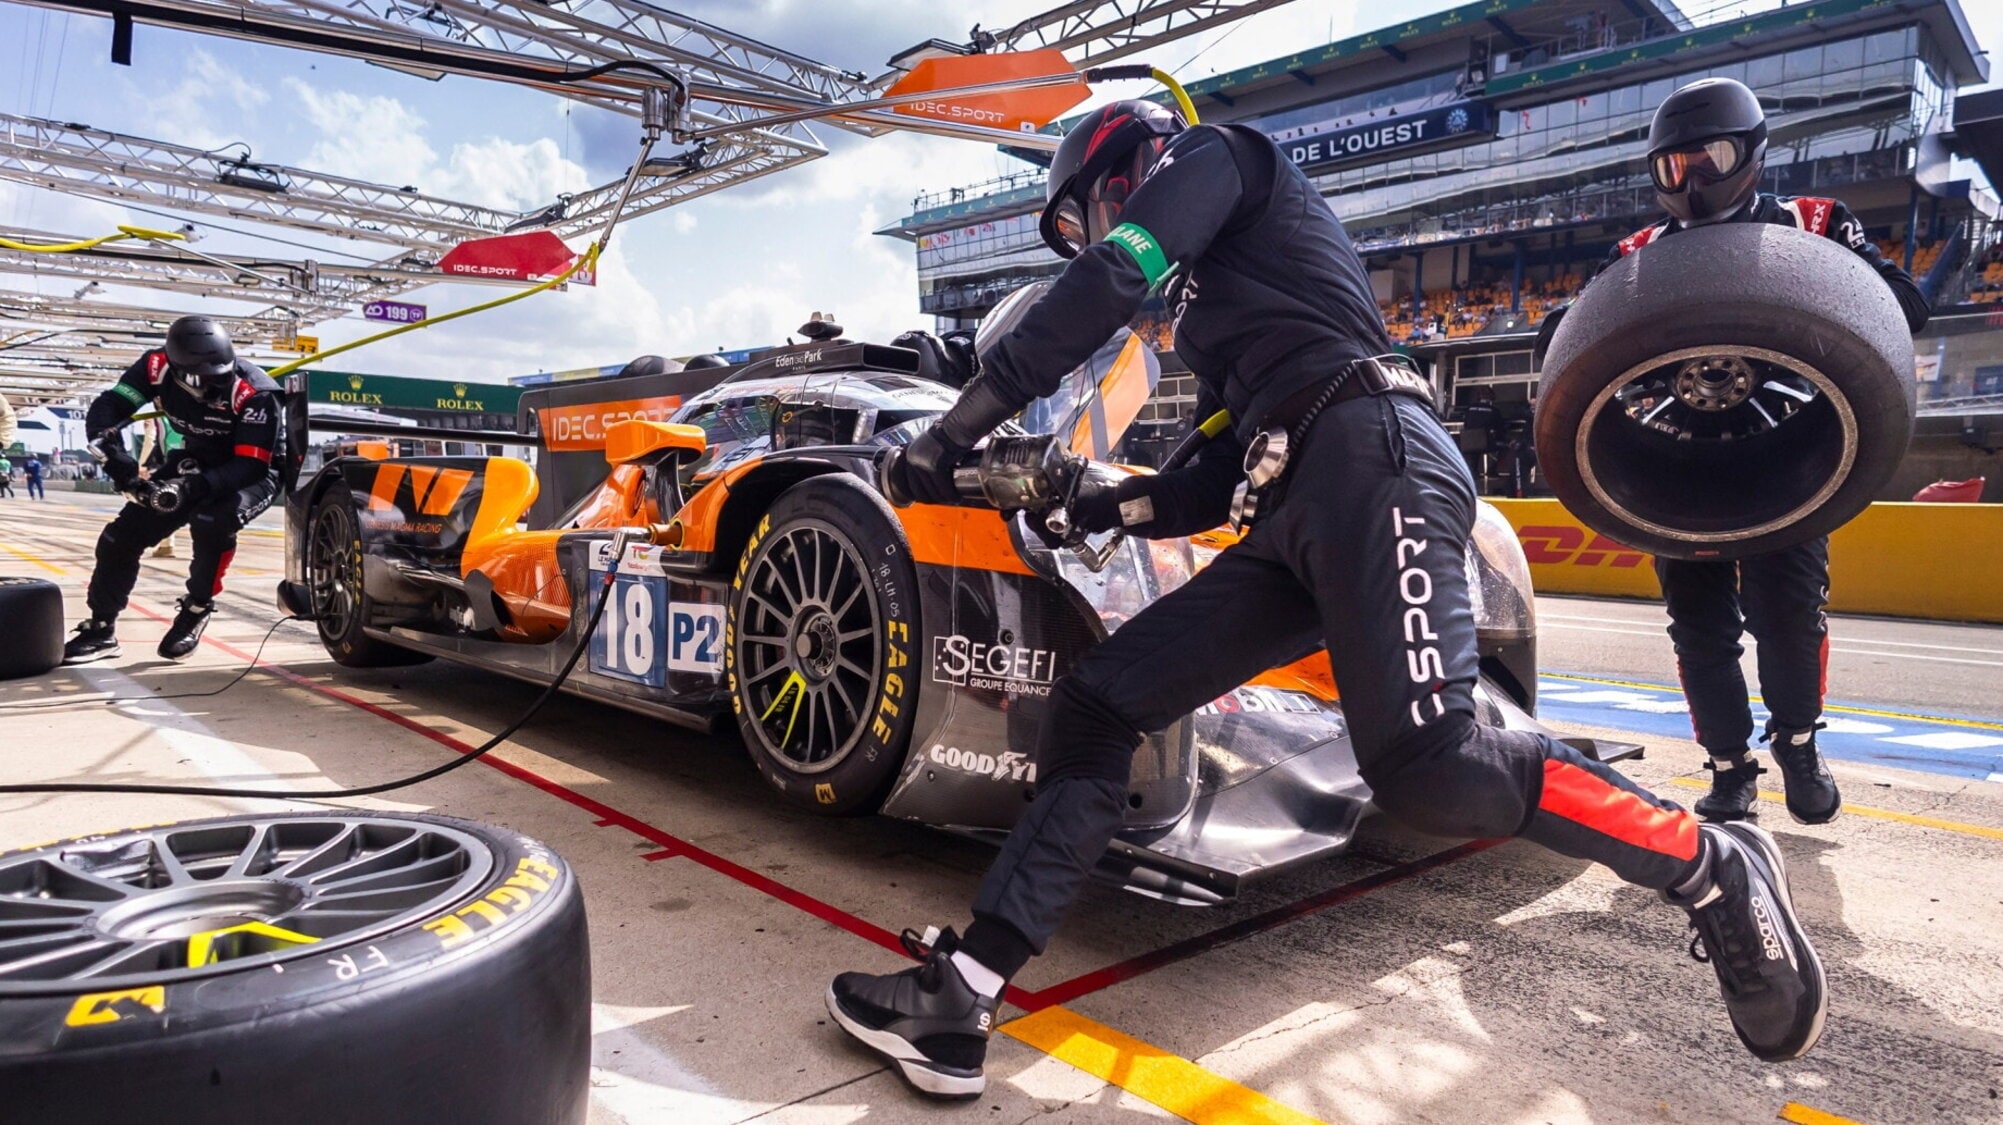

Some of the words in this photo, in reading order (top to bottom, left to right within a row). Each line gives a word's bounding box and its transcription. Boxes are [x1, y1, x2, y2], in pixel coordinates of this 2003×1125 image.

[910, 101, 1005, 123] IDEC.SPORT
[1292, 143, 1321, 164] DE
[1329, 119, 1428, 157] L'OUEST
[452, 263, 518, 276] IDEC.SPORT
[385, 305, 409, 321] 199
[775, 353, 795, 369] Eden
[804, 347, 823, 363] Park
[329, 390, 384, 405] ROLEX
[436, 397, 485, 412] ROLEX
[553, 406, 678, 441] IDEC.S
[598, 580, 654, 676] 18
[672, 612, 720, 664] P2
[943, 635, 1056, 682] SEGEFI
[872, 620, 908, 745] EAGLE
[969, 677, 1003, 691] GROUPE
[930, 743, 1038, 783] GOODY
[422, 857, 560, 949] EAGLE
[1751, 896, 1784, 961] sparco
